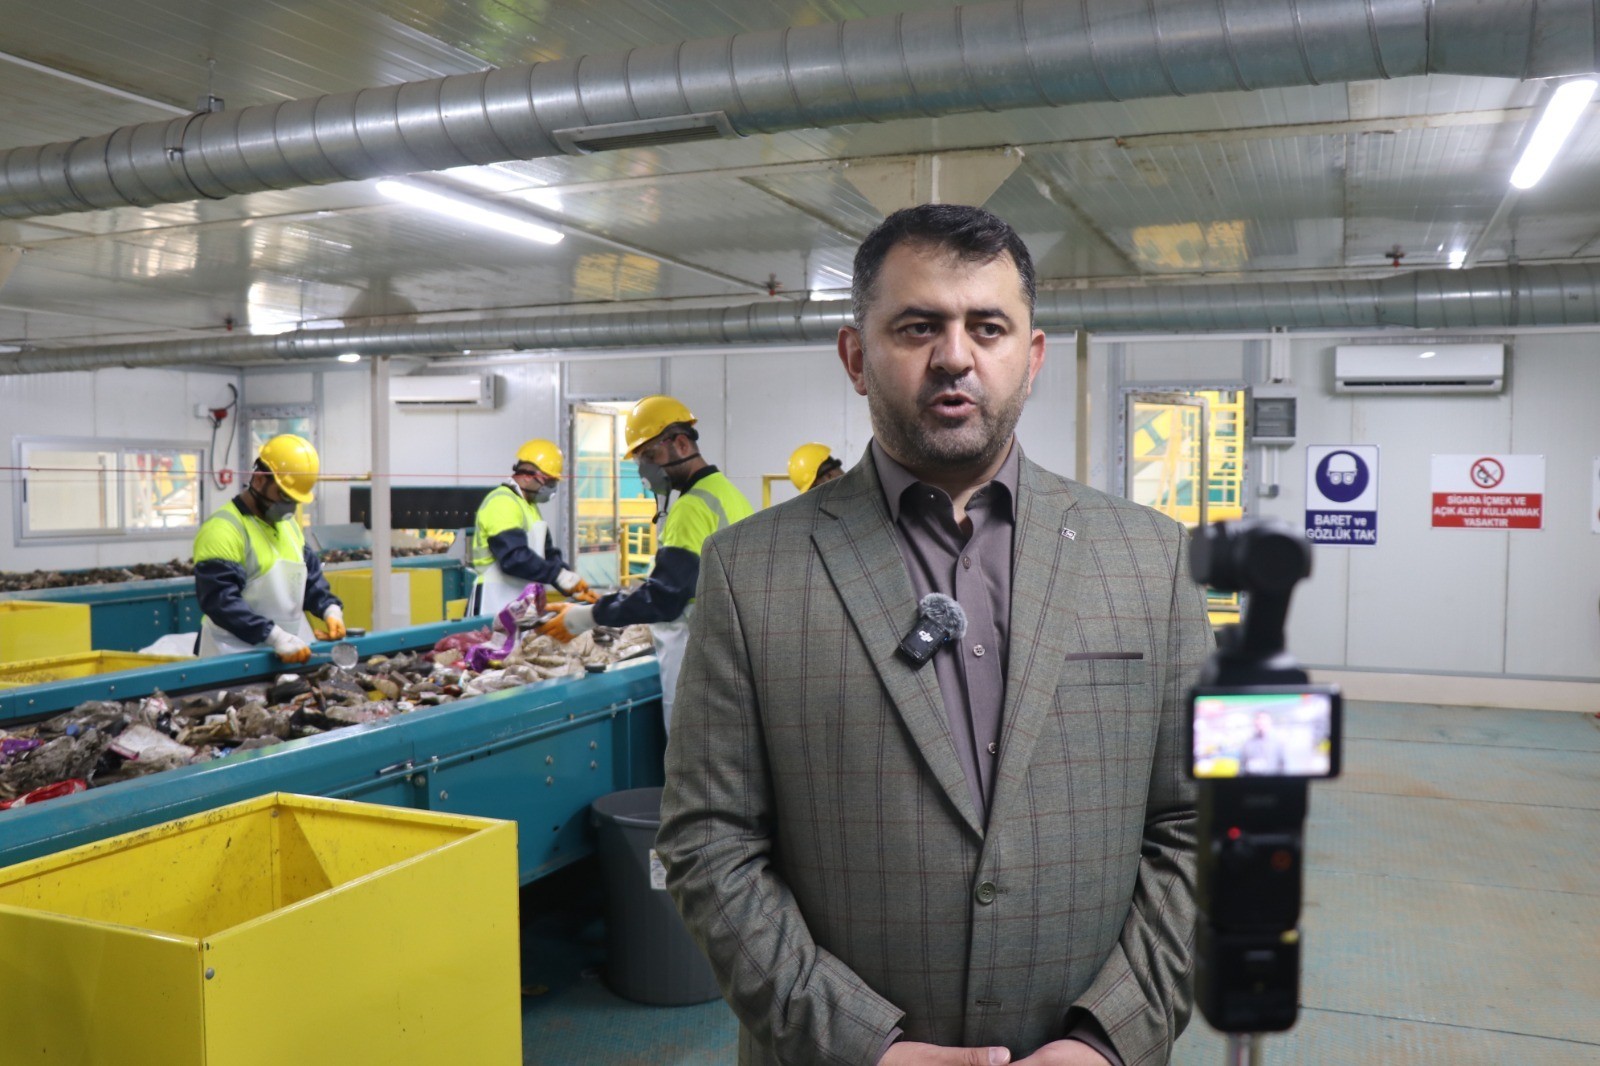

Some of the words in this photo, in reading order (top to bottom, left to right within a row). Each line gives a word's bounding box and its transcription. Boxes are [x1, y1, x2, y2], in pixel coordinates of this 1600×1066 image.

[1447, 495, 1481, 505] SİGARA
[1514, 497, 1527, 505] VE
[1433, 507, 1455, 517] AÇIK
[1457, 507, 1481, 515] ALEV
[1482, 508, 1540, 517] KULLANMAK
[1314, 514, 1352, 527] BARET
[1354, 518, 1367, 527] ve
[1463, 518, 1509, 527] YASAKTIR
[1306, 527, 1351, 540] GÖZLÜK
[1353, 529, 1376, 540] TAK
